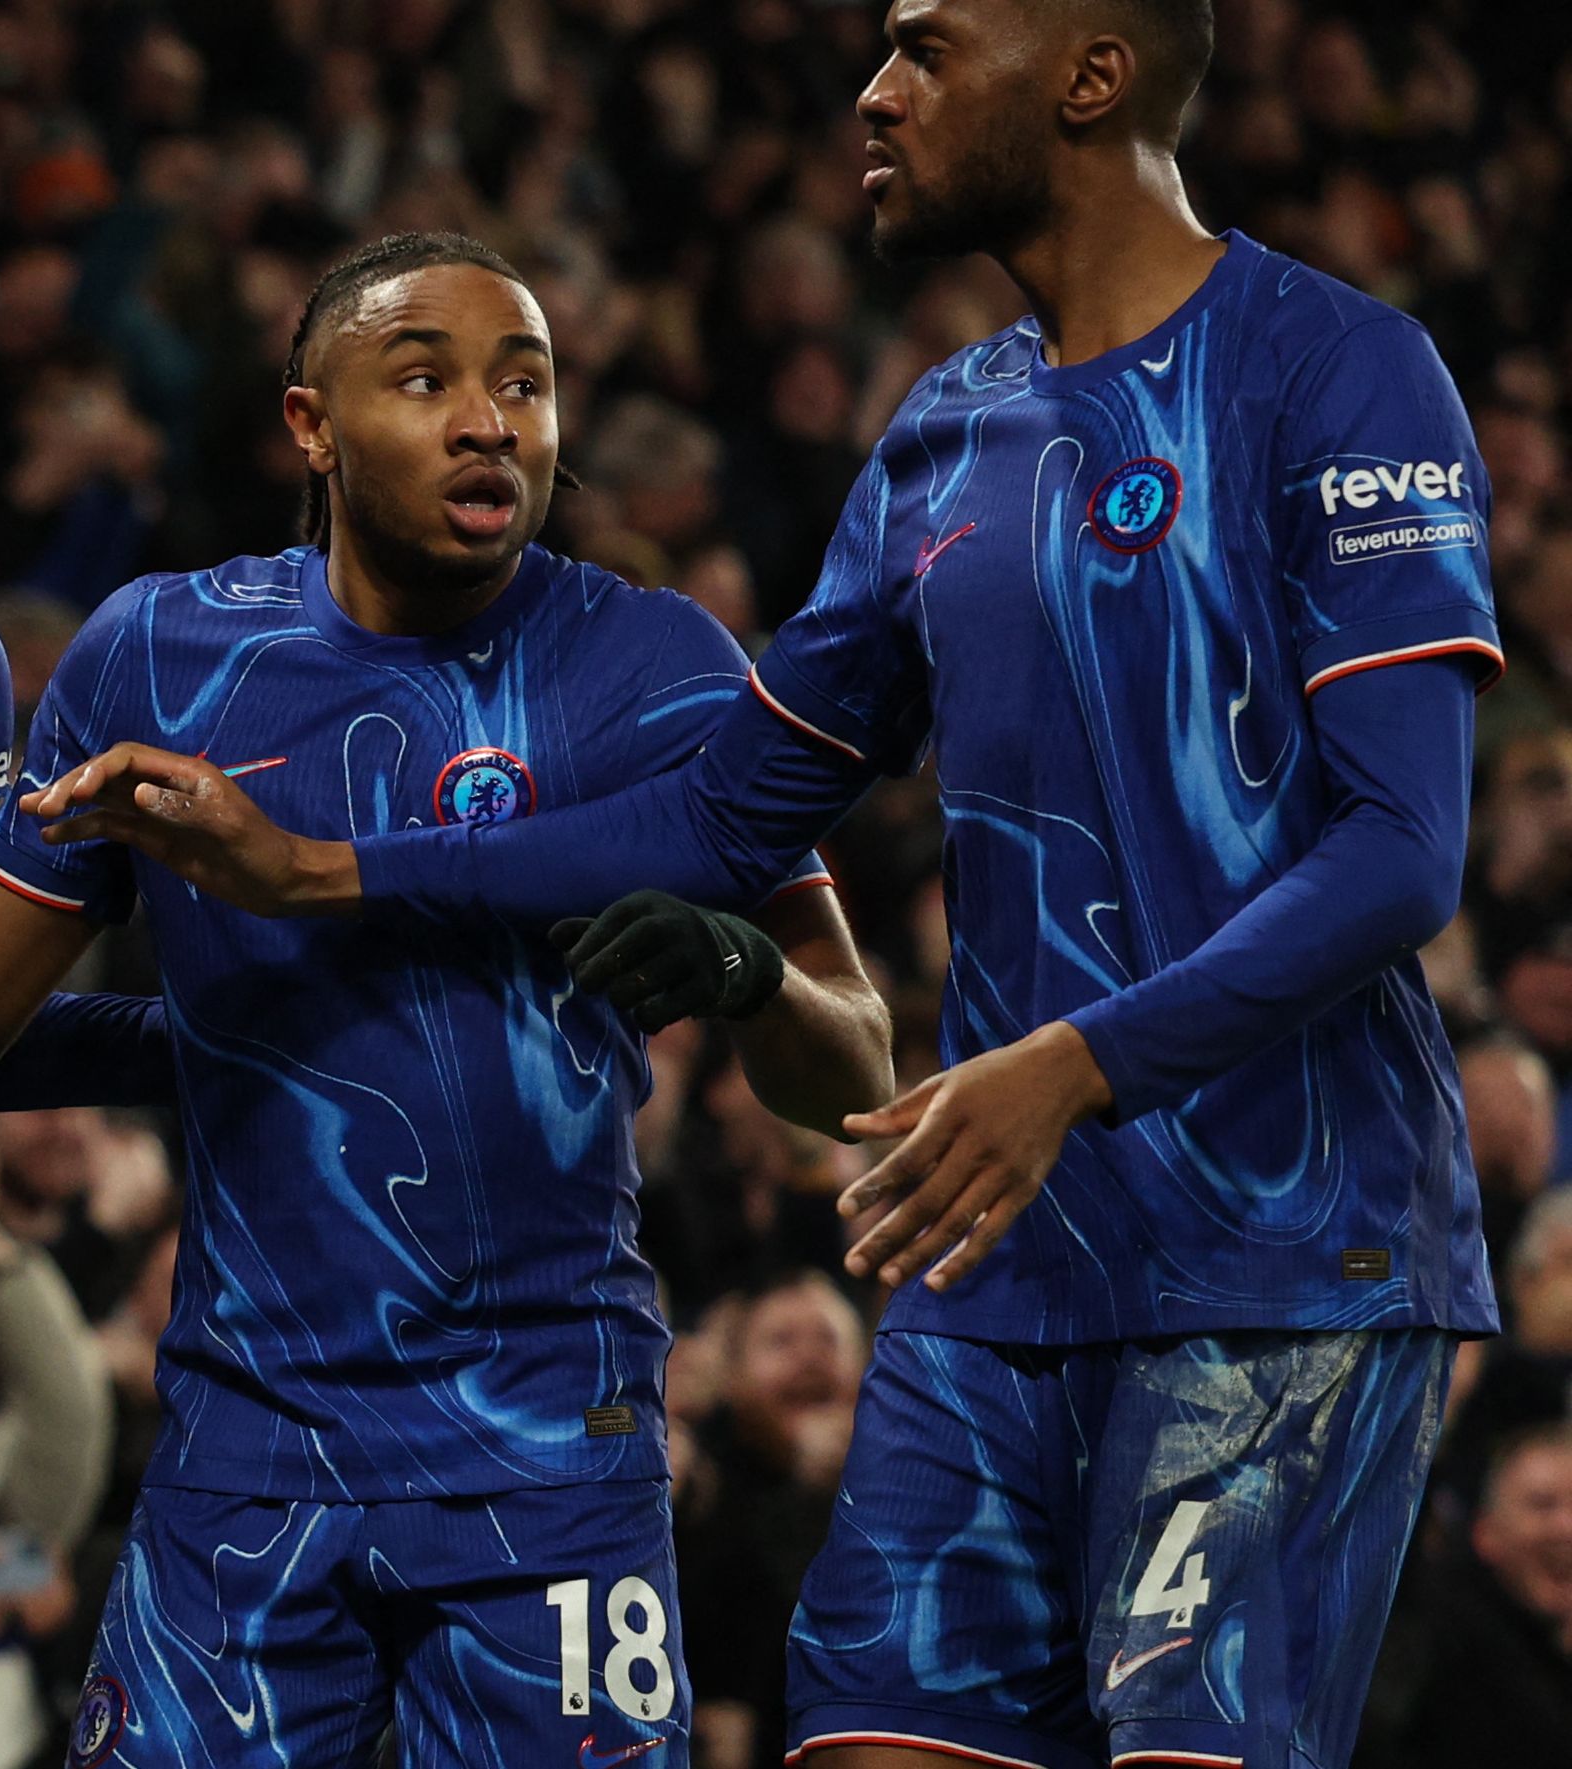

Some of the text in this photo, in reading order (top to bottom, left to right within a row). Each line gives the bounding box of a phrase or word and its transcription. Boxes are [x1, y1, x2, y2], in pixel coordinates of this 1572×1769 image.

[1320, 461, 1464, 515] fever
[1335, 522, 1471, 556] feverup.com
[461, 753, 522, 781] CHELSEA
[1130, 1500, 1210, 1628] 4
[546, 1576, 676, 1722] 18
